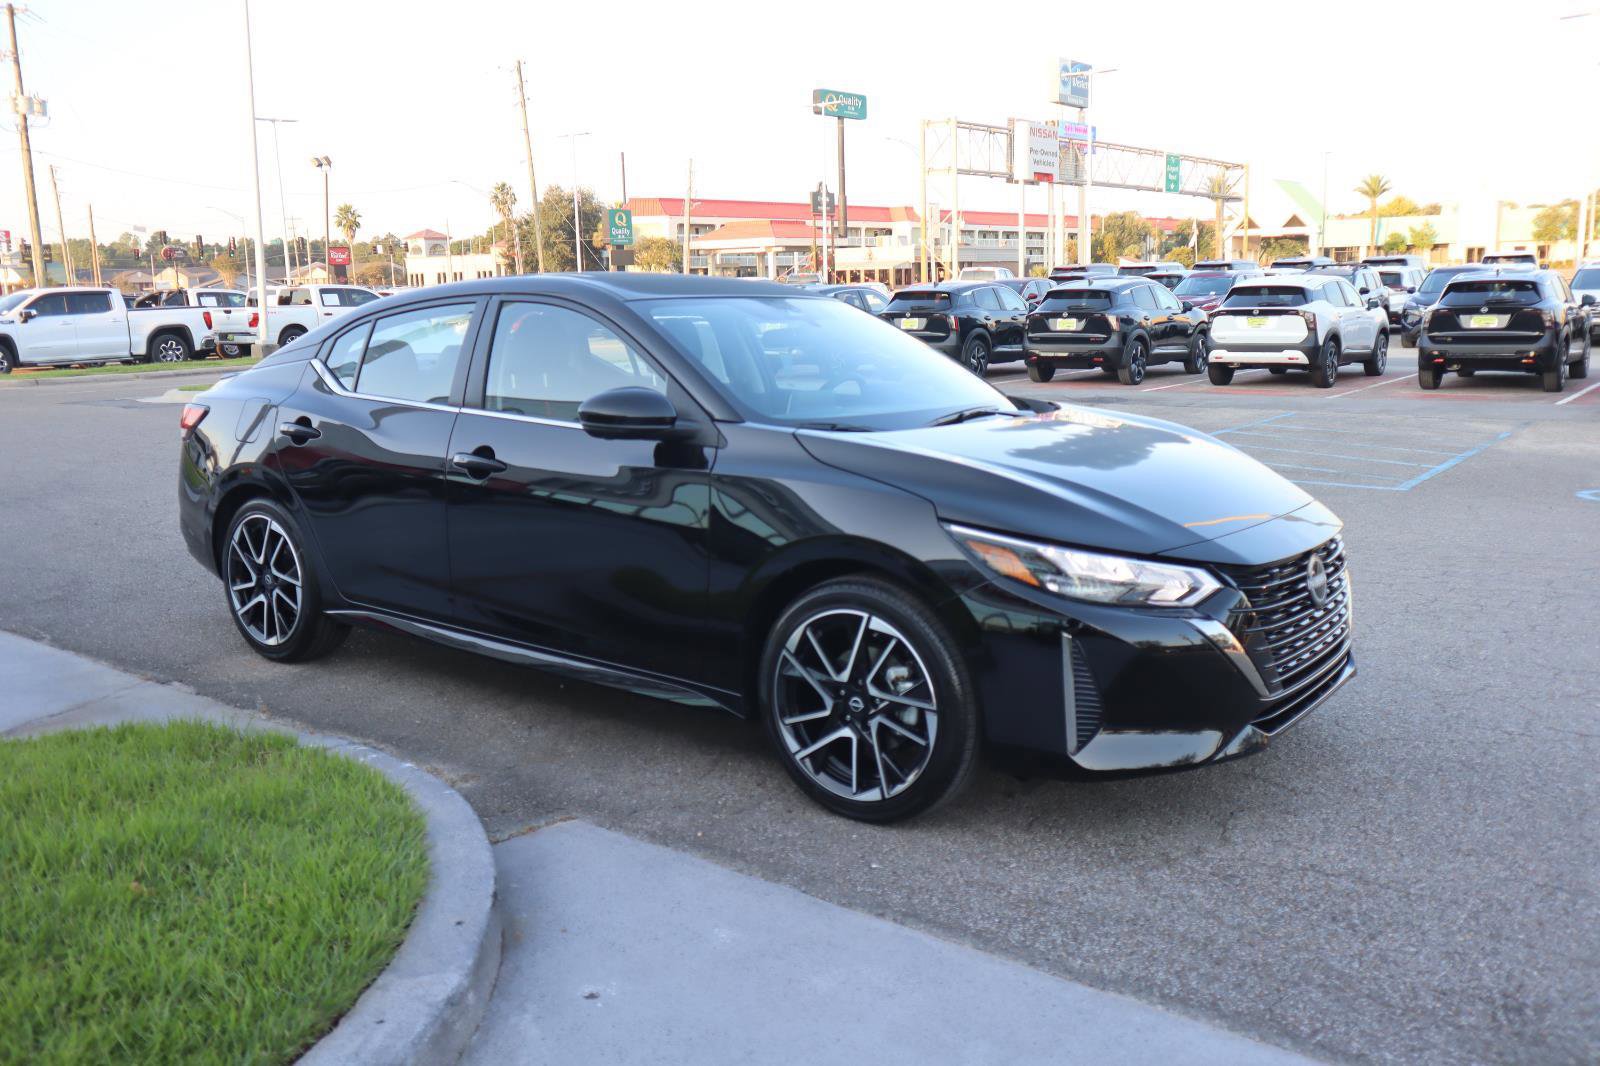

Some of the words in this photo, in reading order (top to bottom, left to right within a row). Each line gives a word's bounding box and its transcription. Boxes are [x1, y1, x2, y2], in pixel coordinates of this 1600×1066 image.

[838, 94, 863, 109] Quality
[1029, 127, 1058, 140] NISSAN
[1029, 147, 1058, 158] Pre-Owned
[1033, 158, 1055, 168] Vehicles
[611, 227, 631, 236] Quality
